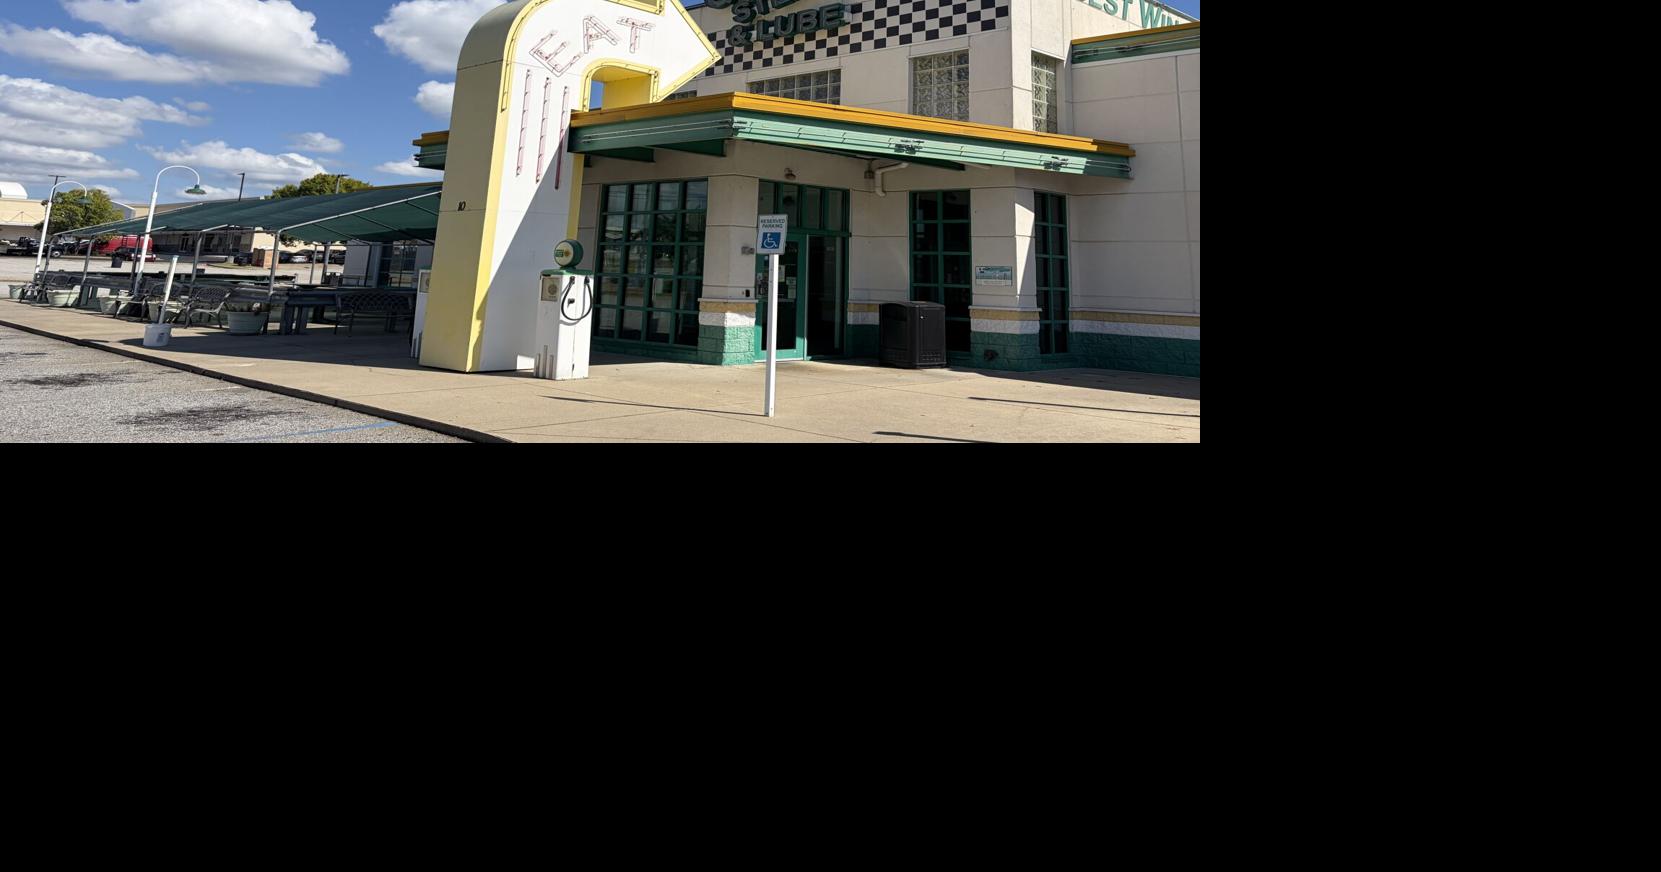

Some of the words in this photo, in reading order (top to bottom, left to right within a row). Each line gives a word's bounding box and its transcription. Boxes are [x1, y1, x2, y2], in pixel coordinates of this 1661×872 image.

[529, 16, 656, 77] EAT
[727, 25, 755, 47] &
[756, 3, 845, 42] LUBE
